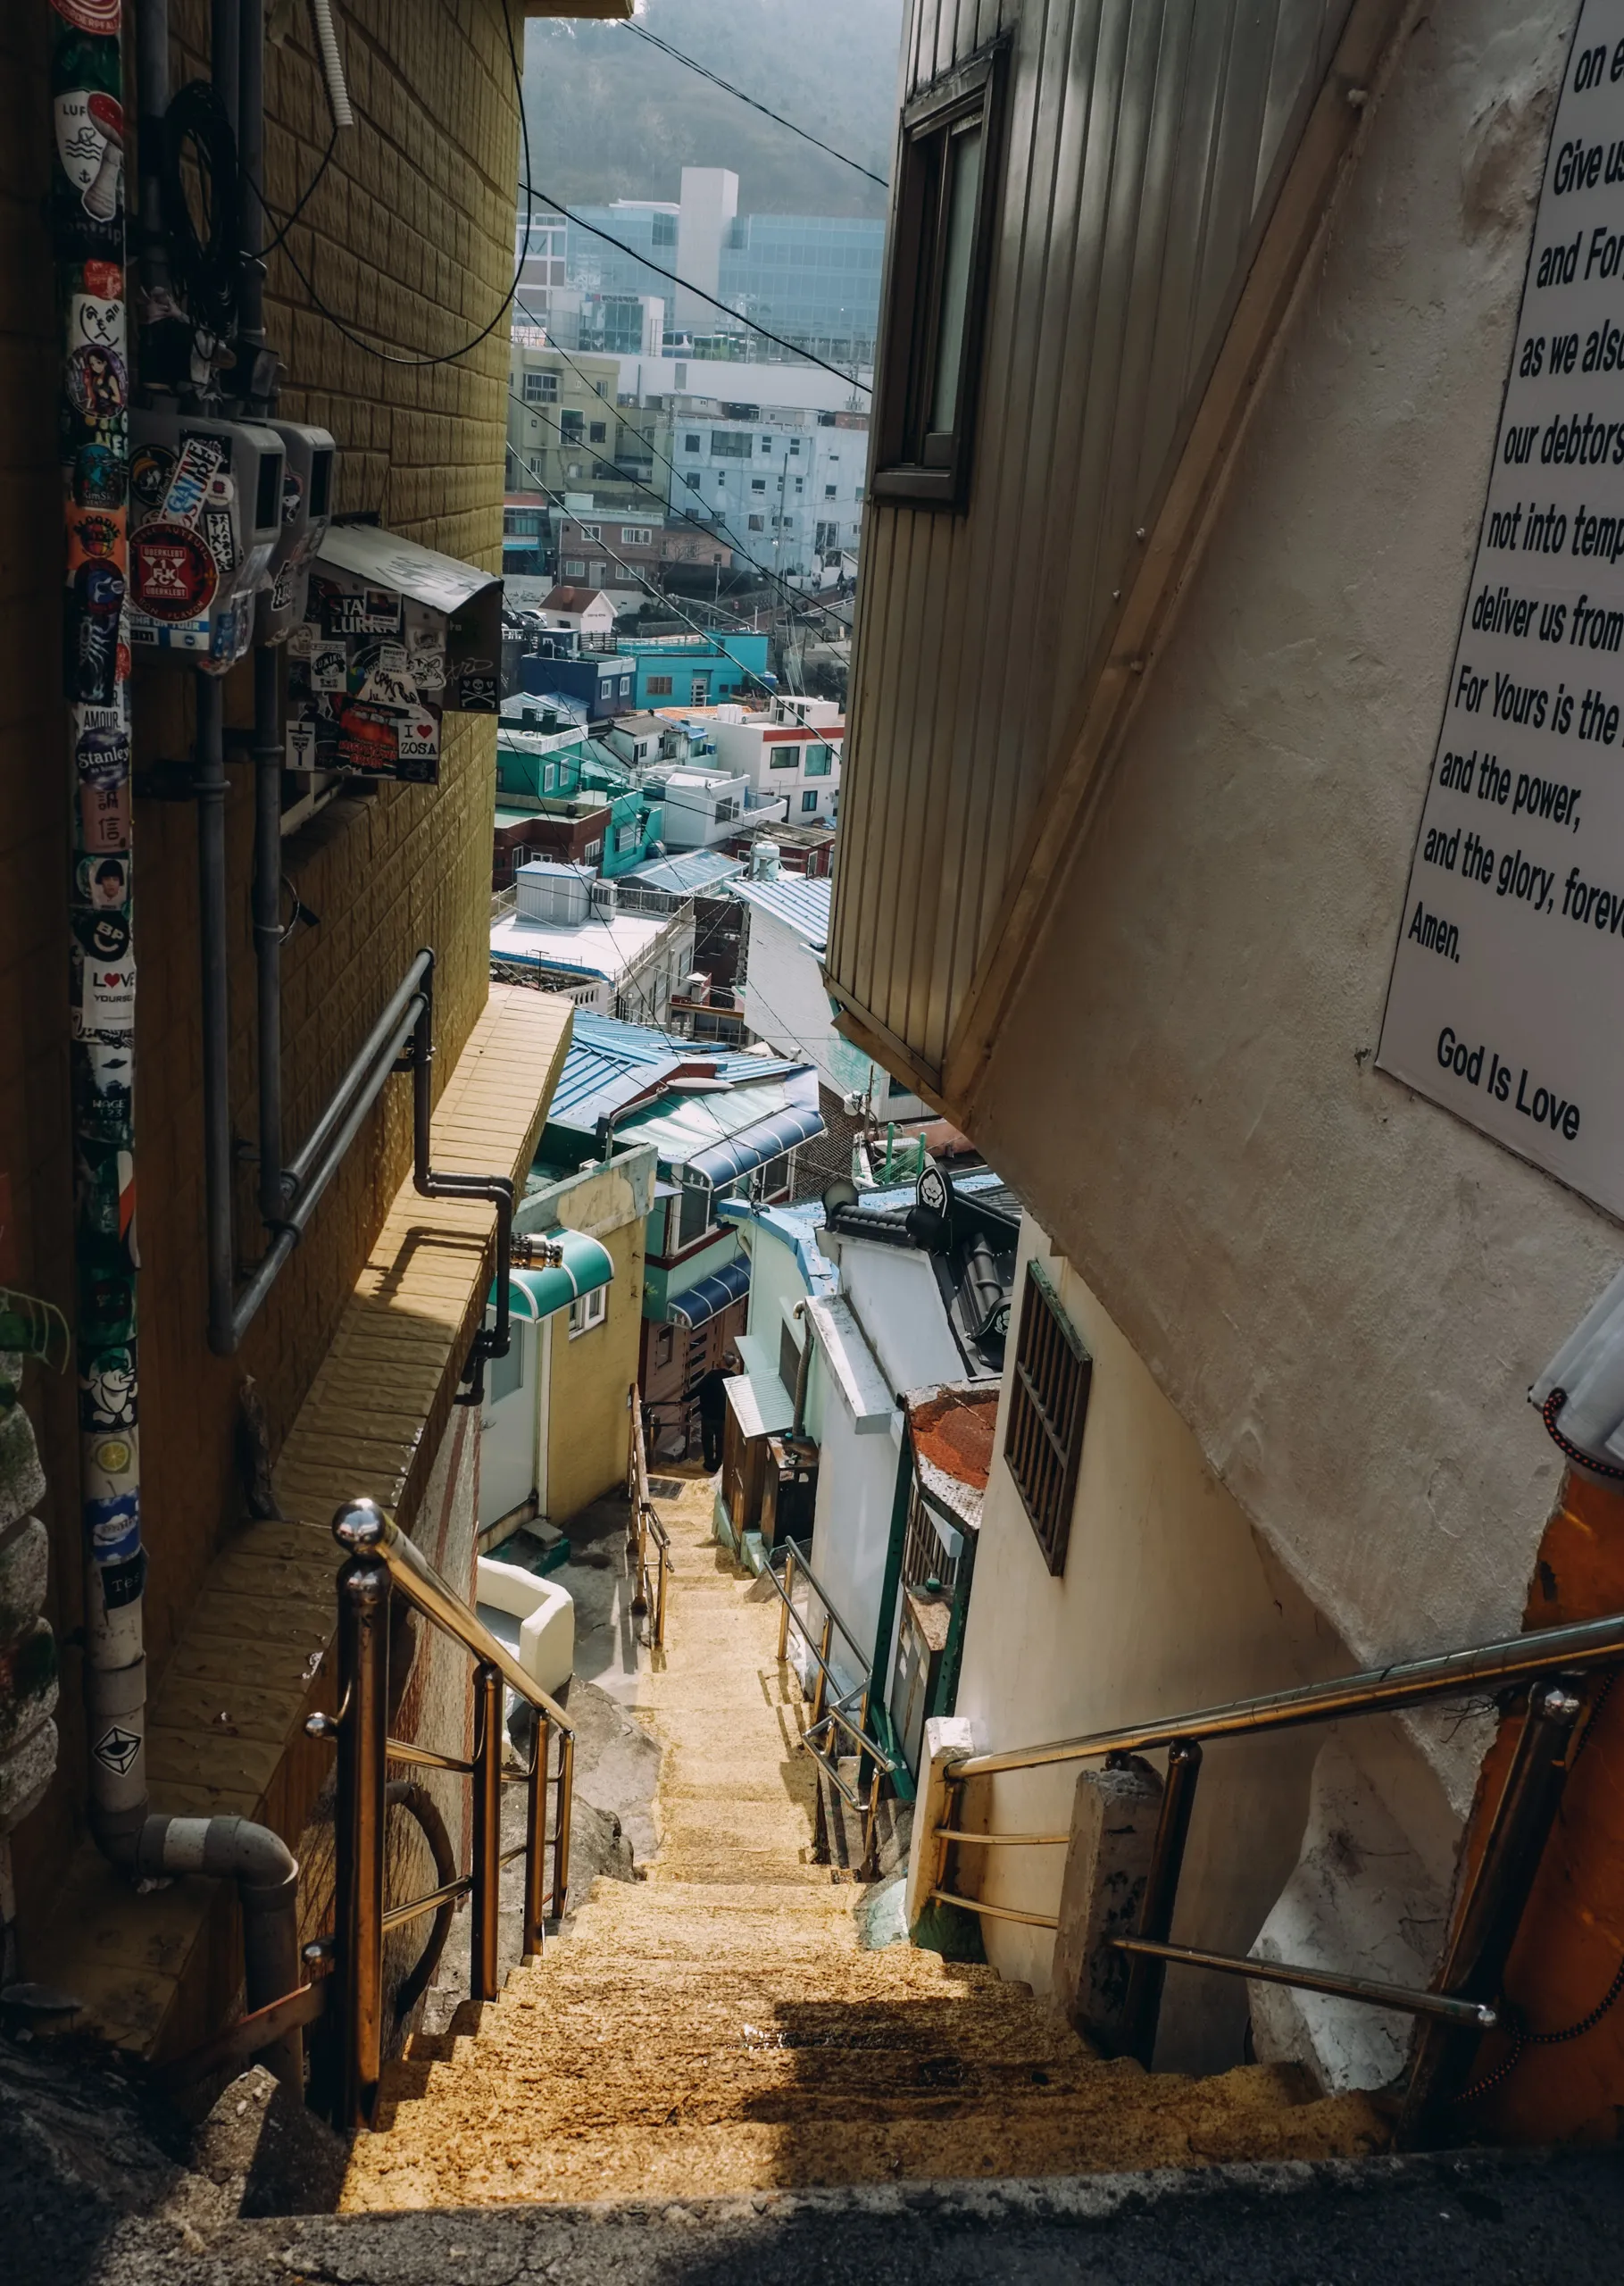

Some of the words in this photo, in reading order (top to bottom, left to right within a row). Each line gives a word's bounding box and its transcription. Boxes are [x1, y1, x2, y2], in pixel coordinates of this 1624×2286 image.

[1574, 45, 1606, 93] on
[1553, 139, 1603, 196] Give
[1537, 231, 1583, 288] and
[1584, 227, 1624, 280] For
[1520, 336, 1545, 378] as
[1549, 333, 1578, 374] we
[1504, 424, 1539, 464] our
[1541, 413, 1624, 465] debtors
[1487, 502, 1522, 550] not
[1522, 503, 1567, 554] into
[1571, 505, 1624, 564] temp
[1472, 585, 1538, 637] deliver
[1539, 604, 1567, 643] us
[1570, 595, 1624, 652] from
[404, 725, 412, 738] I
[1454, 664, 1489, 713] For
[1493, 672, 1548, 729] Yours
[1551, 684, 1574, 734] is
[1578, 689, 1620, 745] the
[78, 746, 129, 769] Stanley
[401, 742, 437, 755] ZOSA
[1440, 750, 1478, 793] and
[1478, 754, 1511, 805] the
[1512, 774, 1581, 833] power,
[1424, 828, 1462, 871] and
[1462, 832, 1494, 884] the
[1496, 849, 1555, 914] glory,
[1562, 867, 1624, 939] forev
[1408, 901, 1460, 964] Amen.
[1437, 1027, 1485, 1086] God
[1487, 1054, 1511, 1101] Is
[1515, 1069, 1579, 1140] Love
